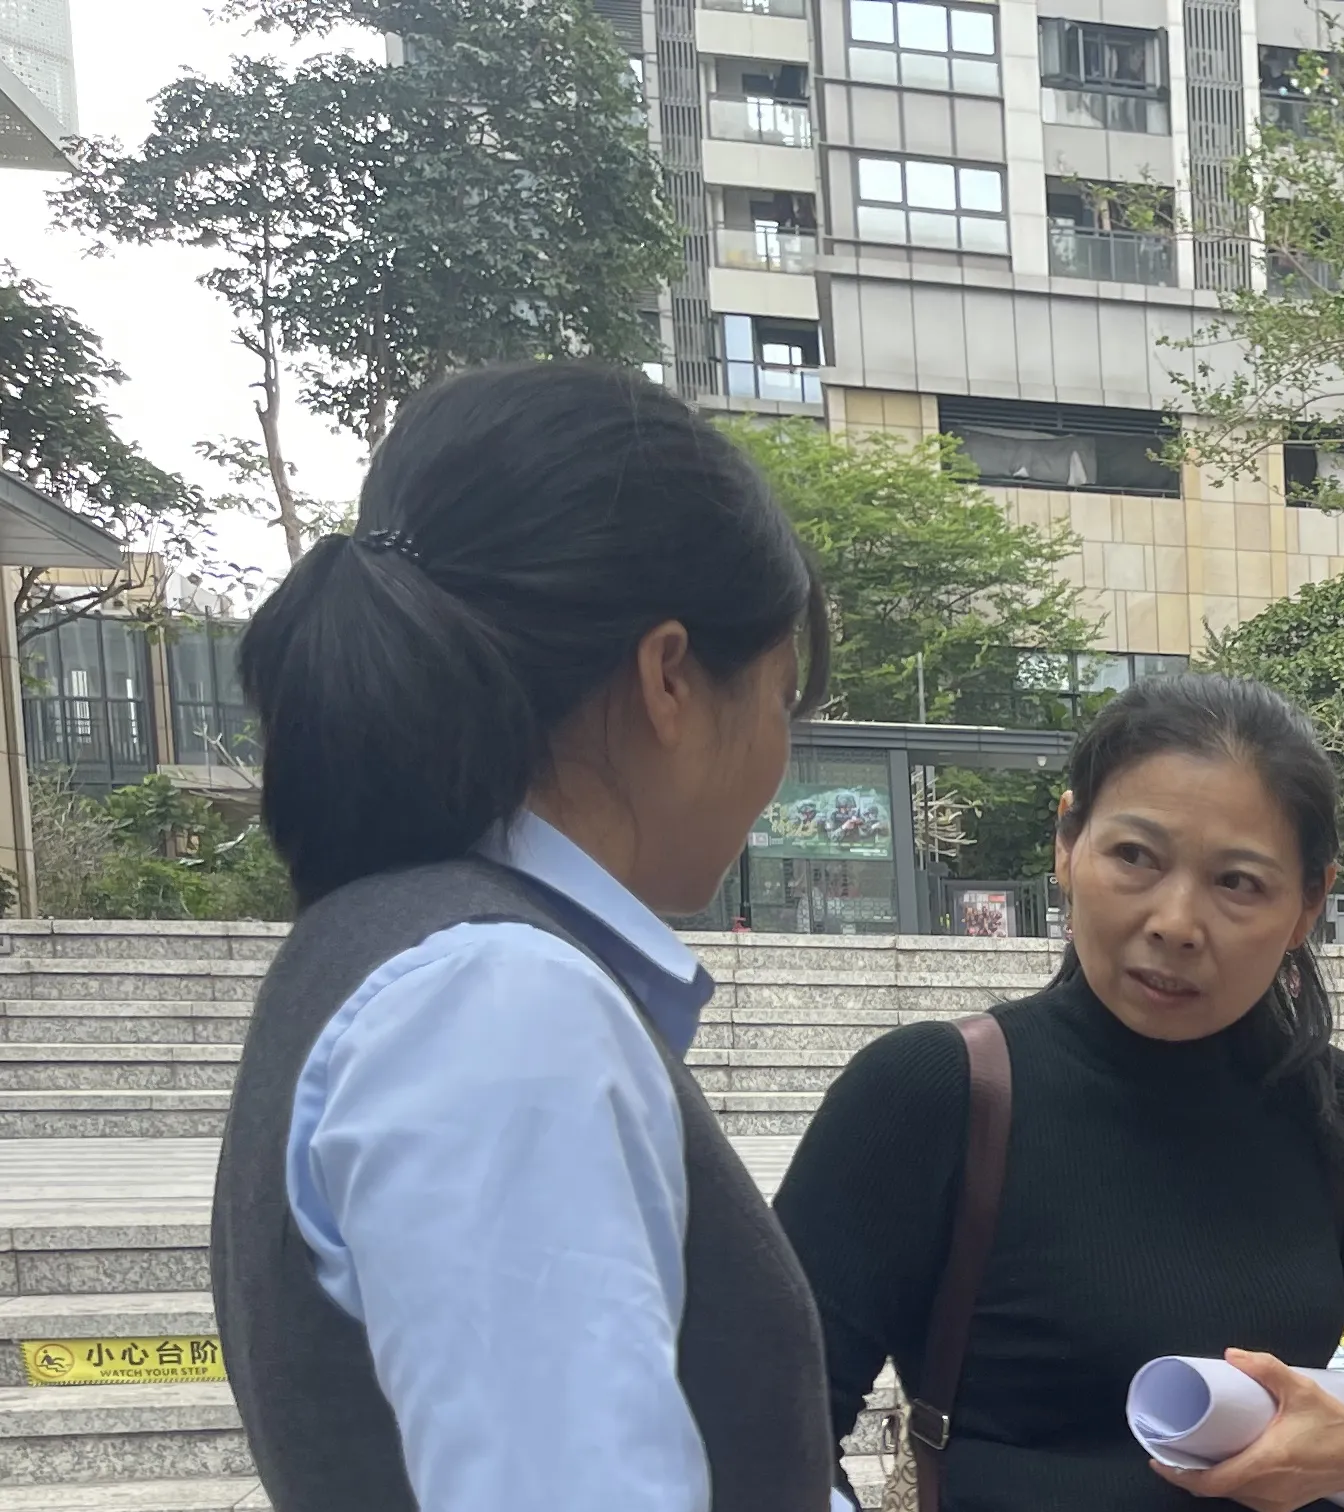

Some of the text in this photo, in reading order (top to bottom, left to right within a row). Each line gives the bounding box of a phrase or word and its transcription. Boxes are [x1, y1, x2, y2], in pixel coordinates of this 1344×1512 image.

[86, 1340, 218, 1367] 小心台阶
[100, 1366, 209, 1378] WATCH YOUR STEP
